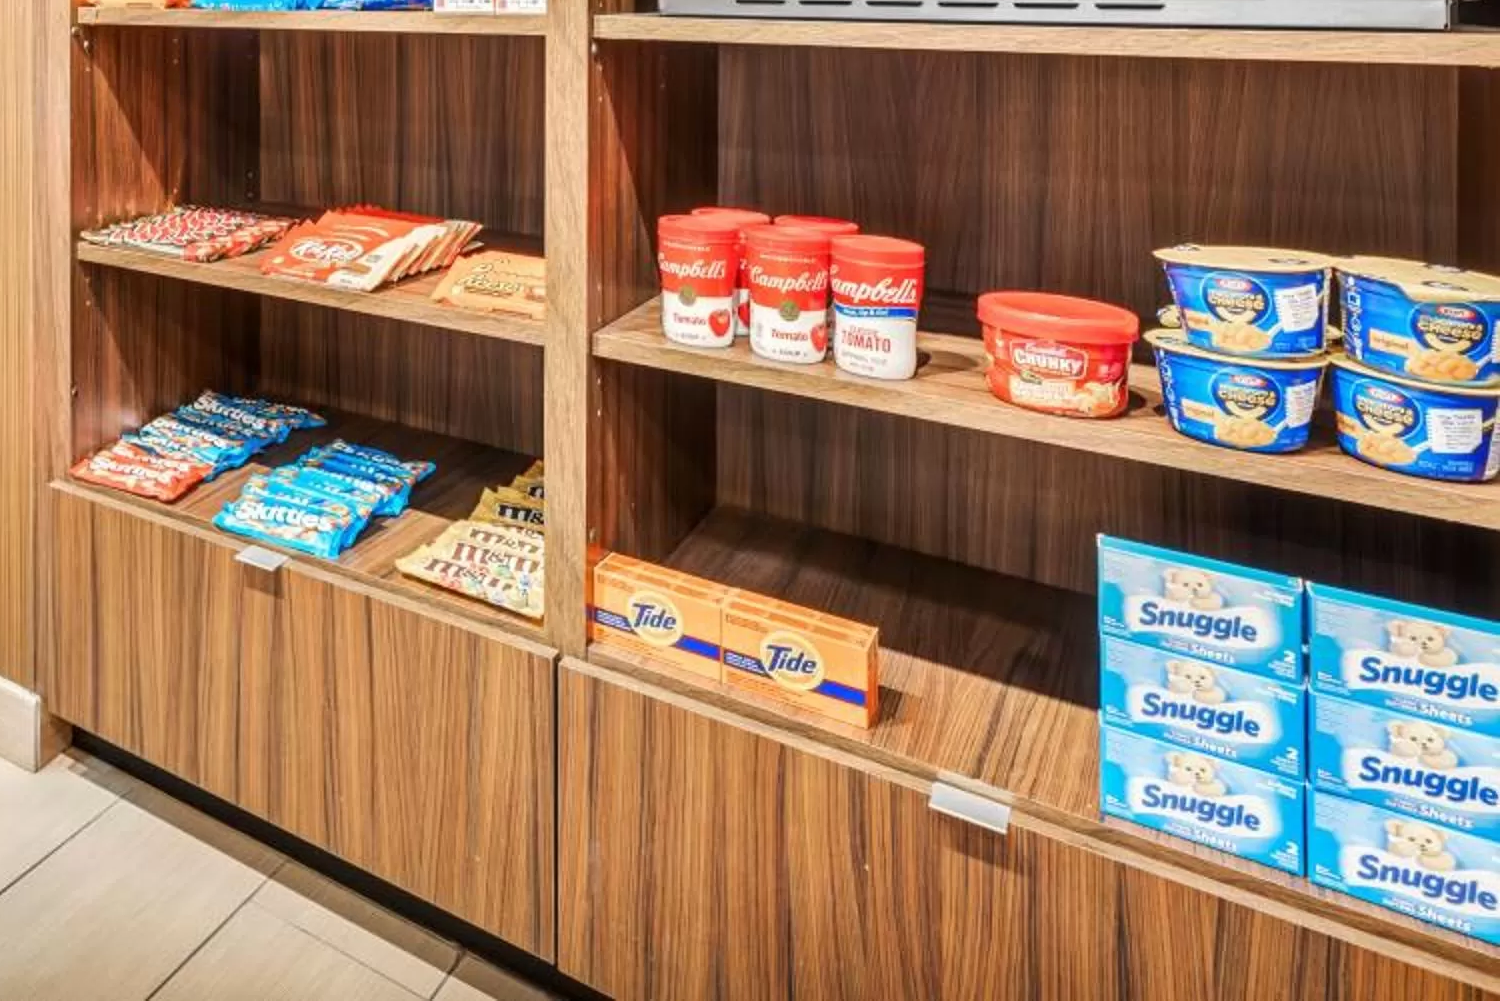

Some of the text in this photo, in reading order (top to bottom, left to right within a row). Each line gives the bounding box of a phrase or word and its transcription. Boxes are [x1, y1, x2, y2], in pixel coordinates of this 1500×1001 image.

[771, 328, 809, 342] Tomato
[841, 329, 892, 354] TOMATO
[234, 500, 333, 533] Skittles
[631, 601, 677, 631] Tide
[1138, 601, 1258, 644] Snuggle
[765, 643, 817, 675] Tide
[1358, 656, 1499, 701] Snuggle
[1141, 692, 1261, 739] Snuggle
[1358, 756, 1499, 806] Snuggle
[1141, 784, 1261, 832] Snuggle
[1356, 854, 1498, 911] Snuggle
